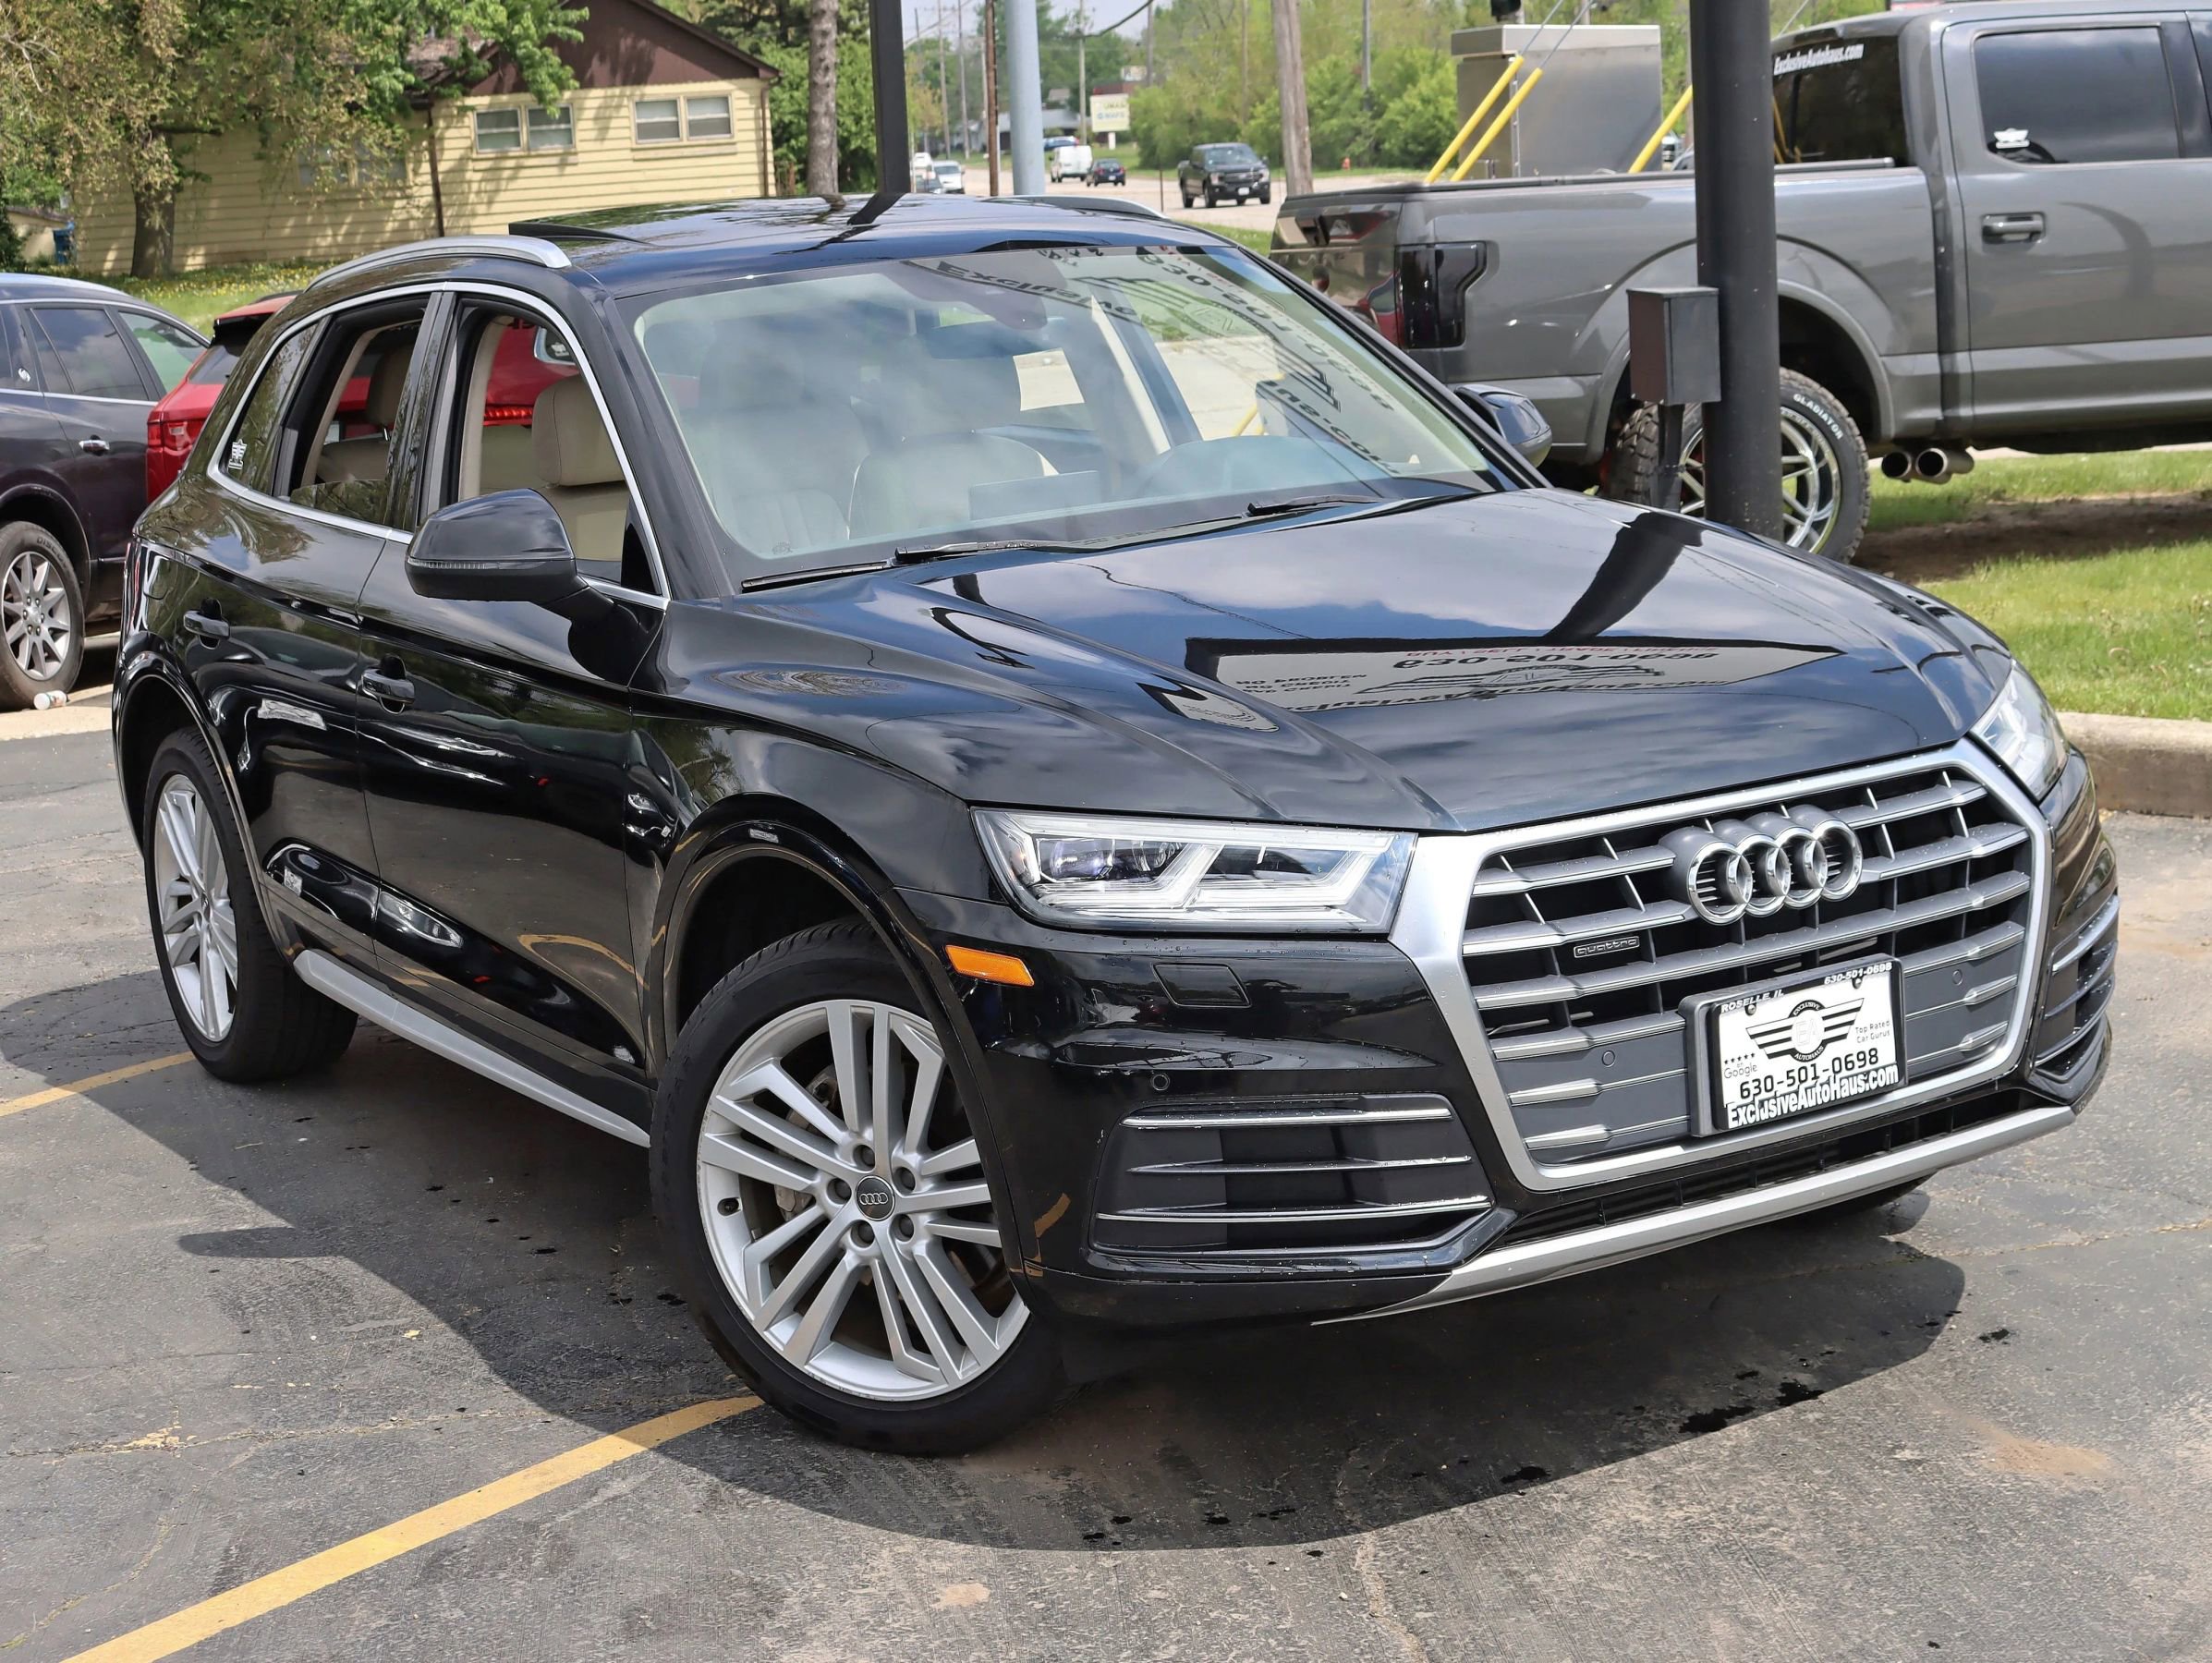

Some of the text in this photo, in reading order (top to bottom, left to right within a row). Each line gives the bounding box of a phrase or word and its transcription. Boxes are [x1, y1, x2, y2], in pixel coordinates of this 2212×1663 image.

[1793, 393, 1844, 441] GLADIATOR
[1576, 939, 1637, 955] quattro
[1823, 962, 1893, 986] 630-501-0698
[1773, 989, 1784, 999] IL
[1855, 1020, 1890, 1035] Top Rated
[1856, 1030, 1890, 1044] Car Gurus
[1794, 1045, 1824, 1061] AUTOHAUS
[1724, 1062, 1757, 1079] Google
[1739, 1048, 1879, 1100] 630-501-0698
[1727, 1063, 1900, 1129] ExclusiveAutoHaus.com
